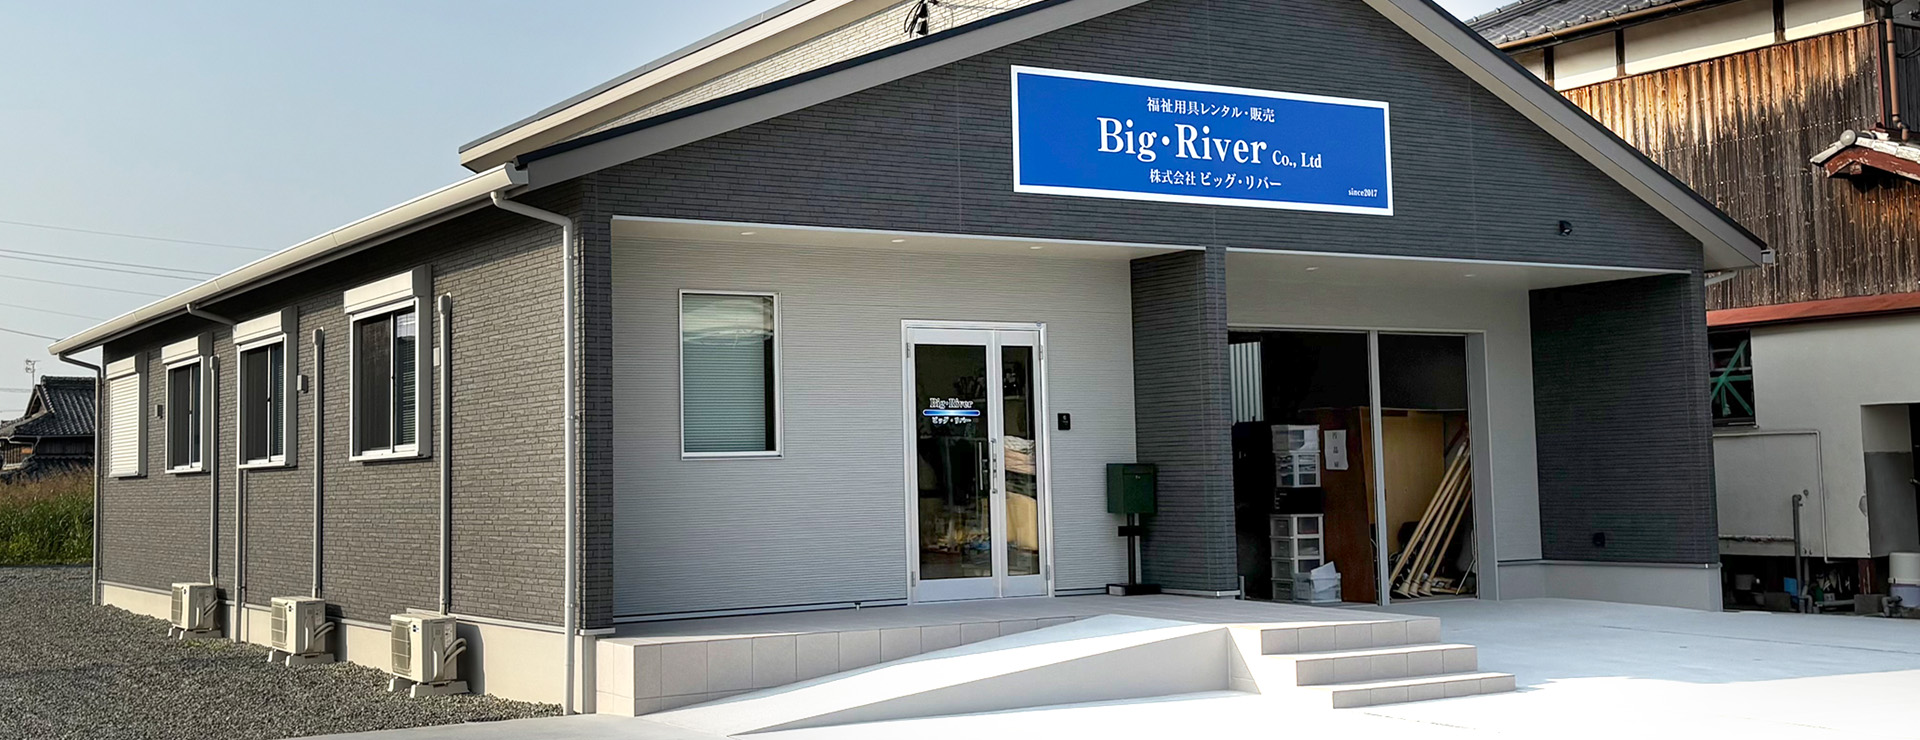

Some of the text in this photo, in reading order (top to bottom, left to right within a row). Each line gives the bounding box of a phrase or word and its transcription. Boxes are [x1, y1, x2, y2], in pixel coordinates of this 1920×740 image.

[1146, 97, 1275, 123] 福祉用具レンタル・販売
[1272, 149, 1297, 169] Co.,
[1300, 152, 1322, 169] Ltd
[1149, 168, 1282, 190] 株式会社 ビッグ・リバー
[1348, 187, 1378, 198] since2017
